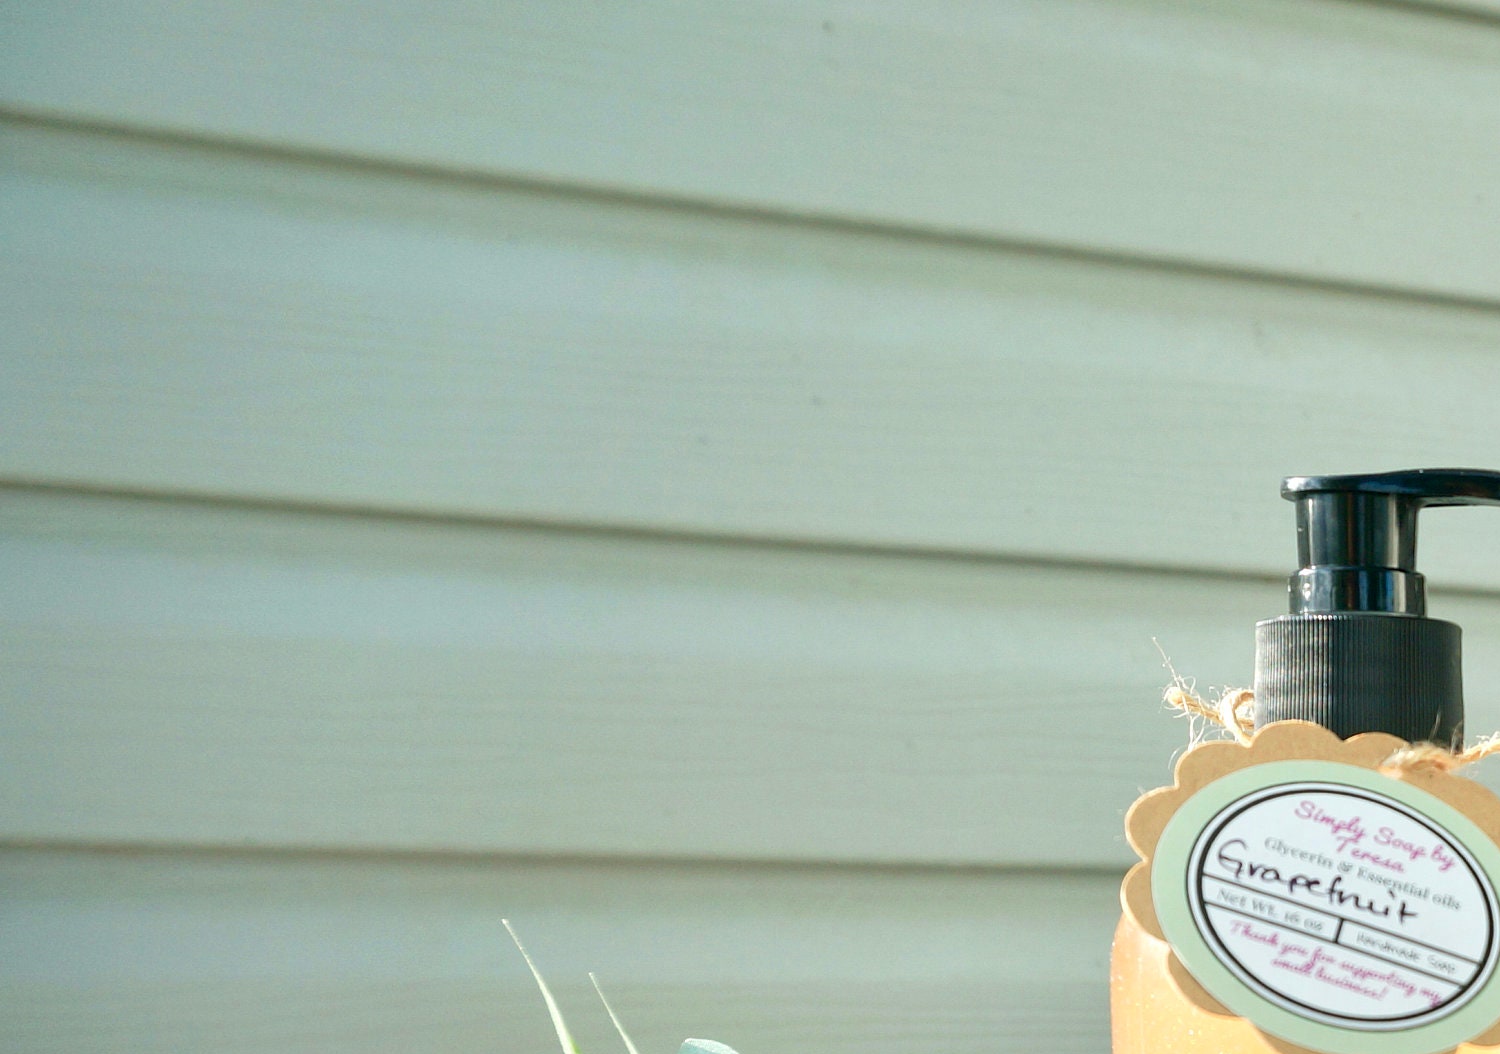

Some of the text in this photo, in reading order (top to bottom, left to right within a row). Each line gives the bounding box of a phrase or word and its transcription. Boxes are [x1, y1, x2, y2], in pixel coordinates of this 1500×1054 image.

[1294, 800, 1455, 872] Simply Soap by
[1336, 835, 1405, 873] Teresa
[1217, 889, 1247, 907] Net
[1218, 837, 1419, 924] Grapefruit
[1264, 836, 1461, 911] Glycerin & Essential oils
[1230, 919, 1443, 1009] Thank you for supporting my
[1271, 955, 1389, 1002] small business!
[1357, 933, 1456, 974] Handmade Soap
